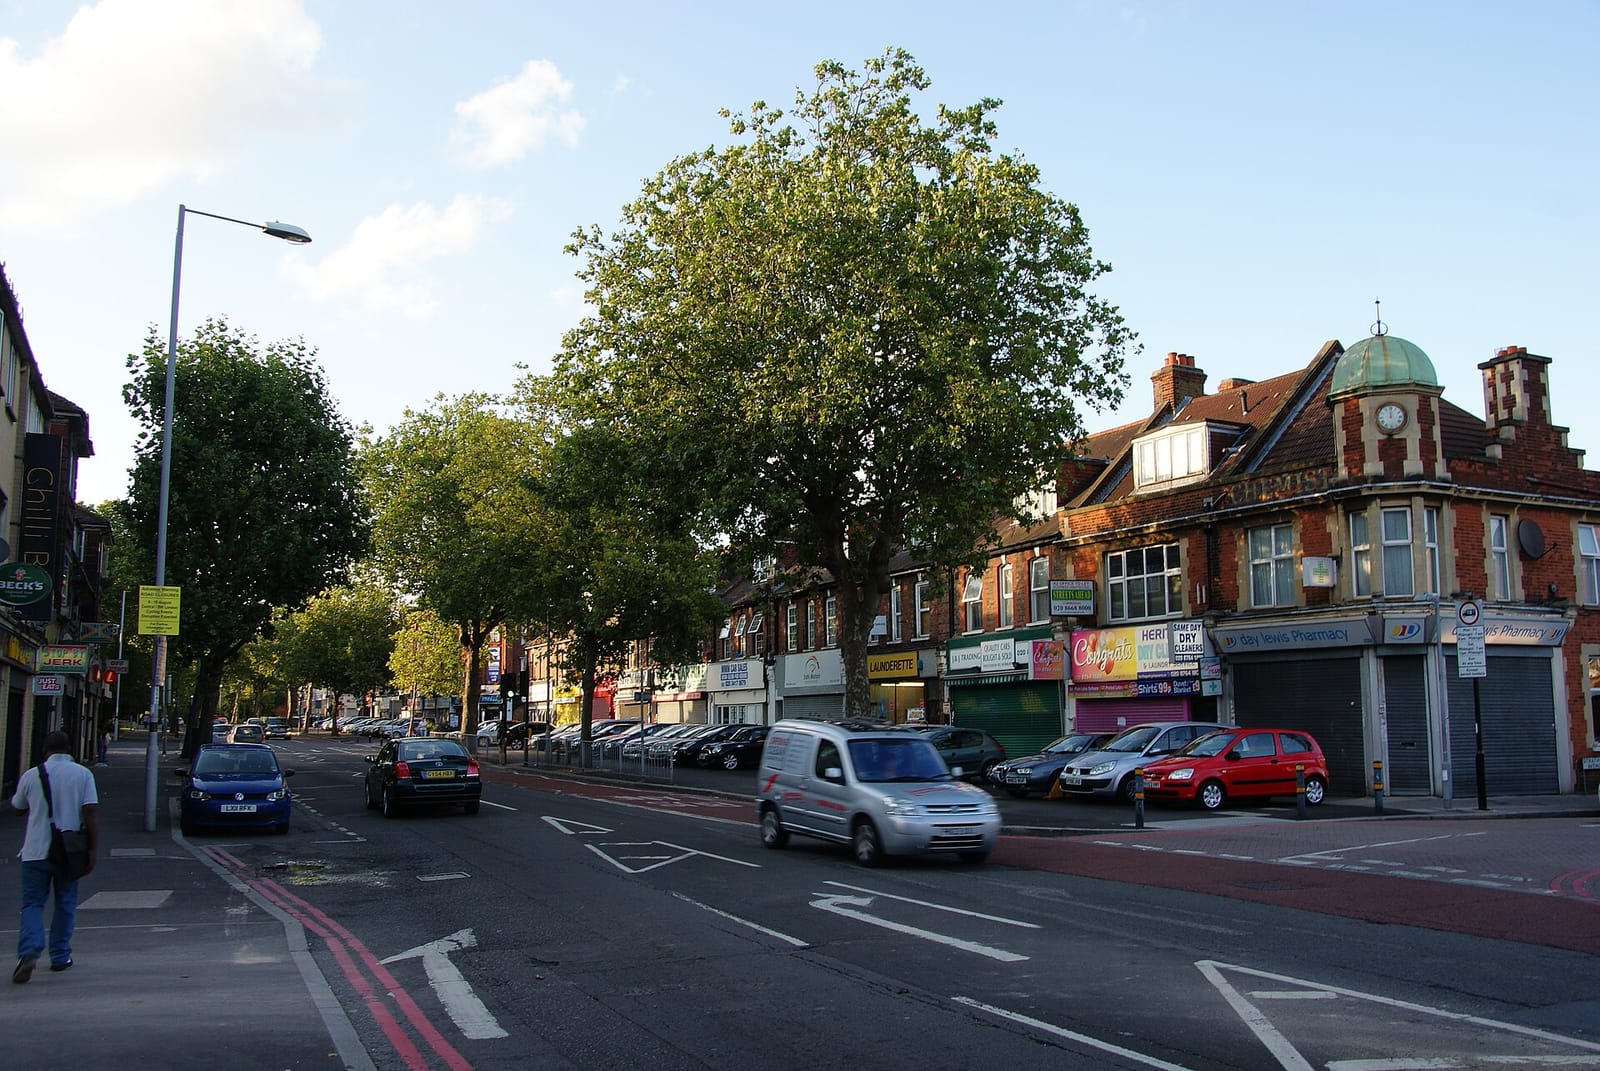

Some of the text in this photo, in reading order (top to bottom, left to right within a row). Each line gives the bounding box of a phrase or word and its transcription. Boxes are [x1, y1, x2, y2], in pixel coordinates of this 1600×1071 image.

[1053, 591, 1074, 599] STREETS
[1173, 623, 1201, 632] SAME DAY
[1500, 626, 1547, 639] Pharmacy
[1179, 633, 1197, 643] DRY
[1240, 629, 1349, 646] day lewis Pharmacy
[43, 648, 68, 657] STOP
[1138, 644, 1153, 659] DRY
[1174, 644, 1203, 653] CLEANERS
[1074, 638, 1132, 671] Congrats
[43, 658, 82, 666] JERK
[870, 659, 913, 672] LAUNDERETTE
[1138, 683, 1157, 694] Shirts
[1158, 682, 1171, 693] 99p
